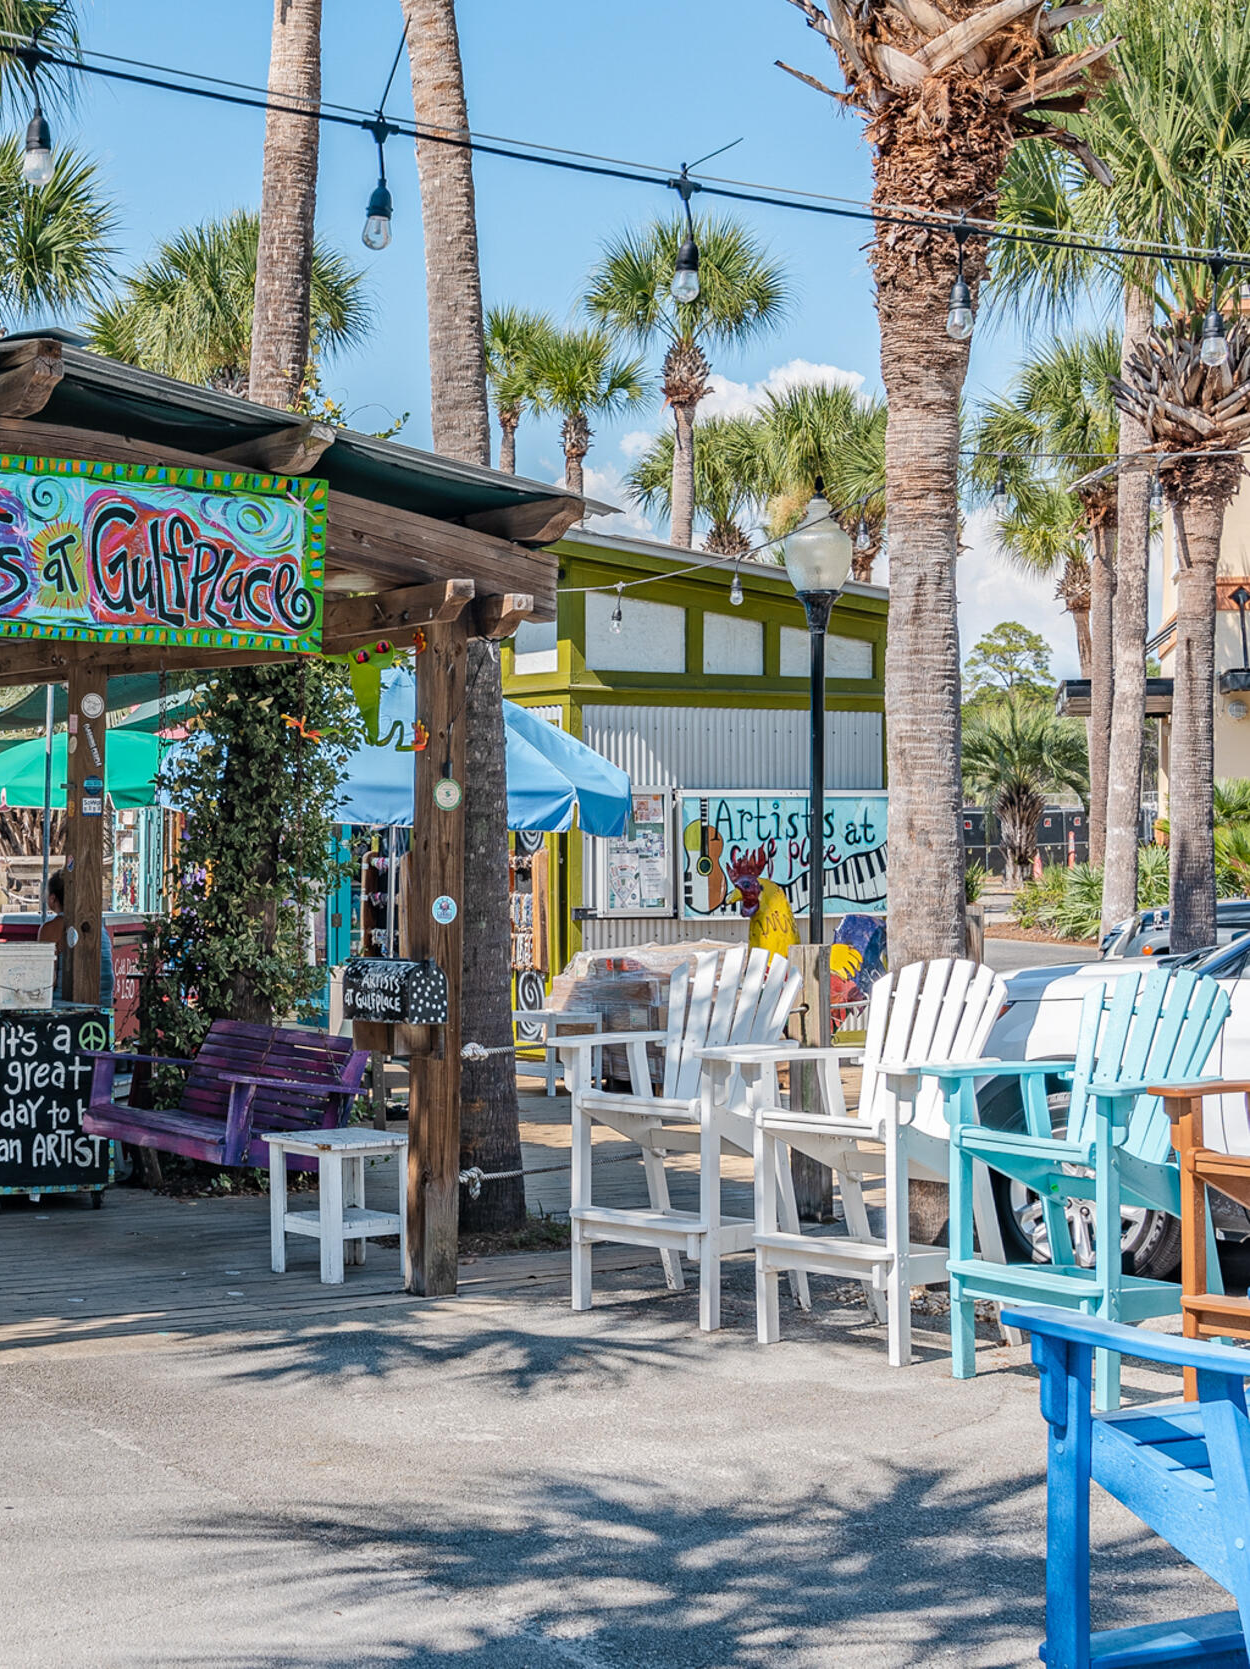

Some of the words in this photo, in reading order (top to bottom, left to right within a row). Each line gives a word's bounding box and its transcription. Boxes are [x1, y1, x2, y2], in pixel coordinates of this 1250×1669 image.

[711, 797, 835, 842] Artists
[844, 806, 876, 845] at
[0, 1024, 38, 1059] It's
[53, 1024, 71, 1054] a
[4, 1056, 92, 1095] great
[47, 1099, 70, 1129] to
[32, 1130, 107, 1168] ARTIST
